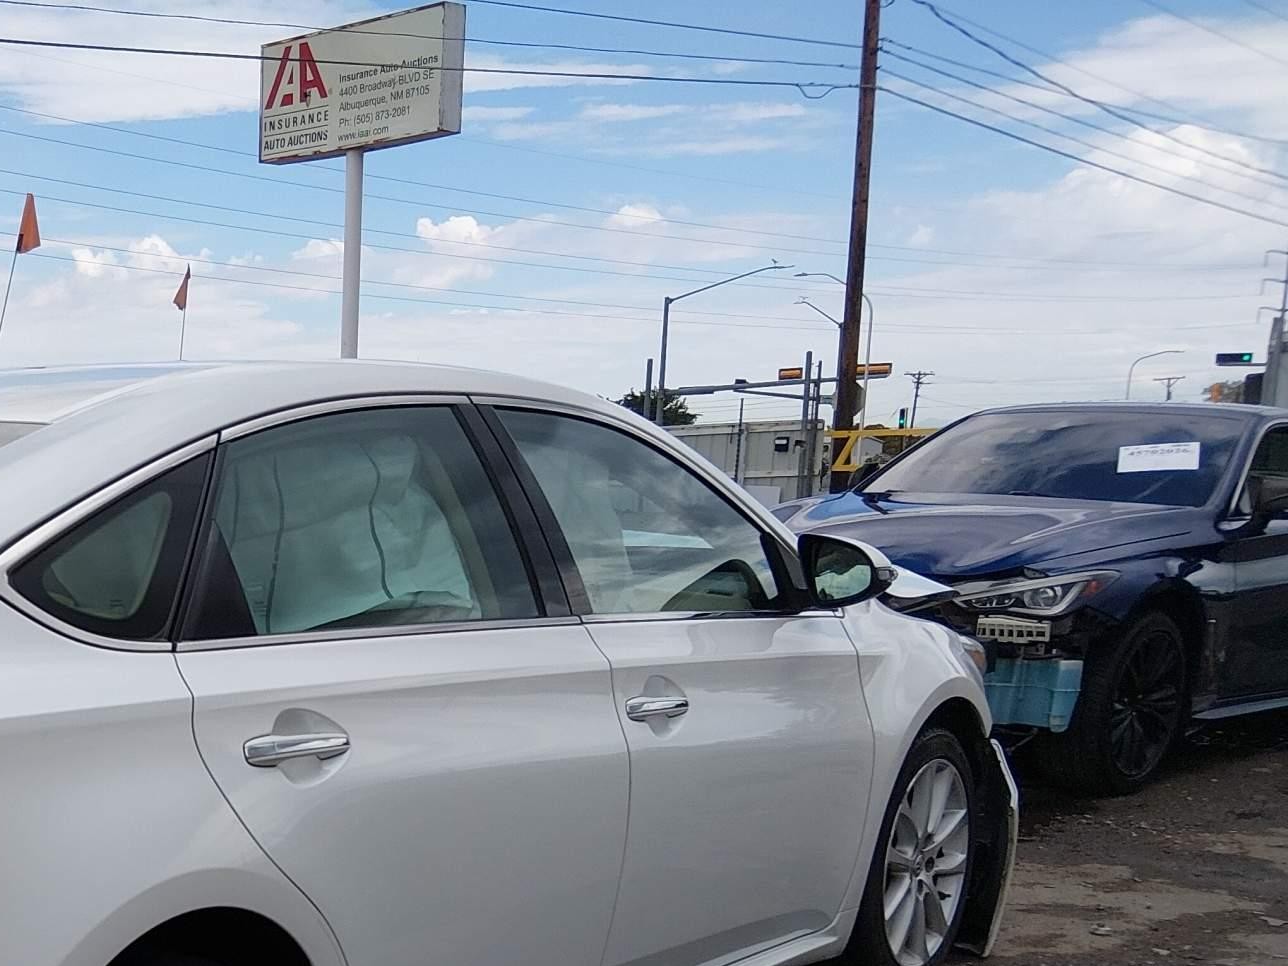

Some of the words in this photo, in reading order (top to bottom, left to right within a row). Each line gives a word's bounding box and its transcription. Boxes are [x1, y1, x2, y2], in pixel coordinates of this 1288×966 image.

[339, 69, 378, 83] Insurance
[380, 64, 399, 74] Auto
[401, 55, 439, 69] Auctions
[339, 85, 358, 97] 4400
[359, 77, 397, 94] Broadway
[398, 71, 421, 86] BLVD
[422, 69, 435, 80] SE
[390, 90, 404, 102] NM
[405, 84, 430, 99] 87105
[264, 110, 329, 133] INSURANCE
[353, 112, 374, 127] (505)
[375, 105, 411, 121] 873-2081
[264, 137, 286, 152] AUTO
[287, 130, 329, 147] AUCTIONS
